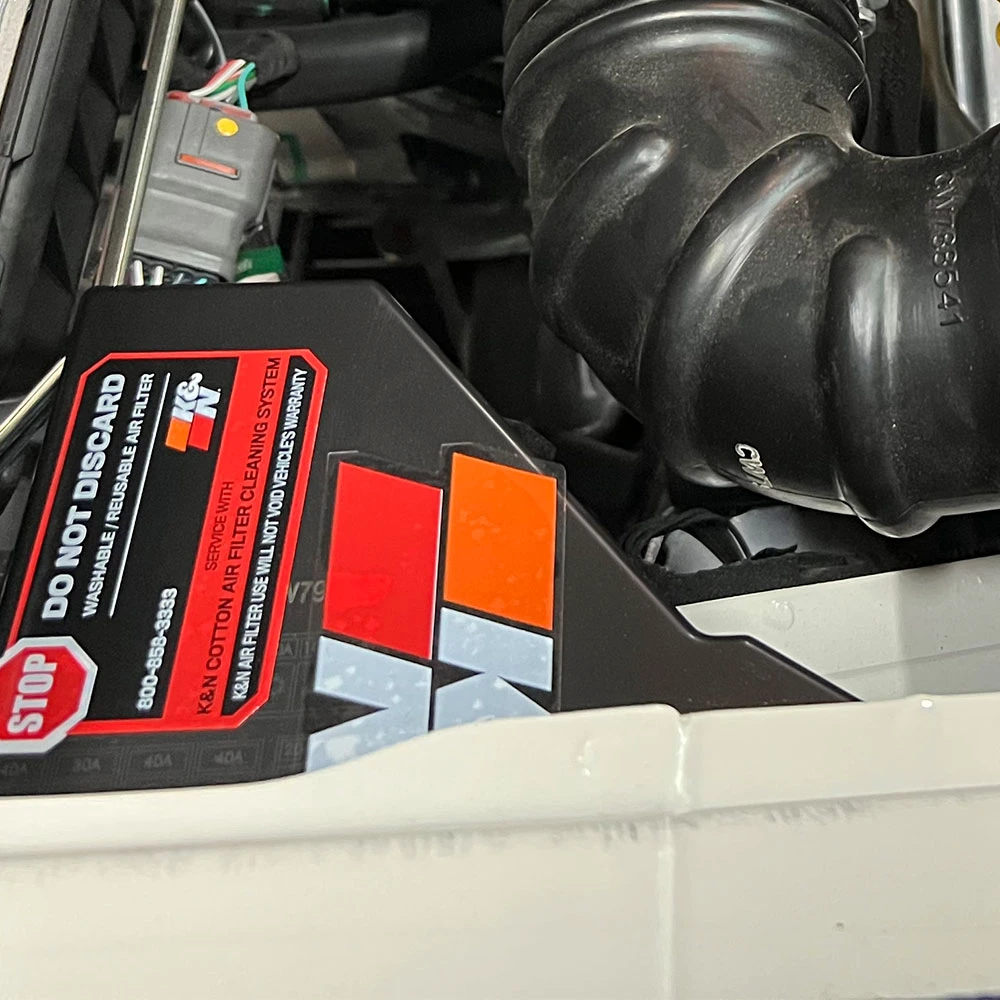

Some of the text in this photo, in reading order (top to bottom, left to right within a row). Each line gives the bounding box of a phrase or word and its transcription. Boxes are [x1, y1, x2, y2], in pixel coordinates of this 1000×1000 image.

[131, 373, 155, 418] FILTER
[283, 367, 308, 430] WARRANTY
[125, 420, 143, 443] AIR
[41, 374, 126, 619] DO NOT DISCARD
[105, 445, 137, 521] REUSABLE
[267, 489, 286, 518] VOID
[197, 357, 281, 714] K&N COTTON AIR FILTER CLEANING SYSTEM
[205, 481, 235, 571] SERVICE WITH
[262, 518, 280, 544] NOT
[82, 531, 116, 618] WASHABLE
[256, 545, 275, 576] WILL
[250, 576, 269, 602] USE
[242, 604, 264, 646] FILTER
[135, 587, 178, 711] 800-858-3333
[238, 646, 256, 669] AIR
[7, 653, 58, 734] STOP
[231, 671, 252, 700] K&N
